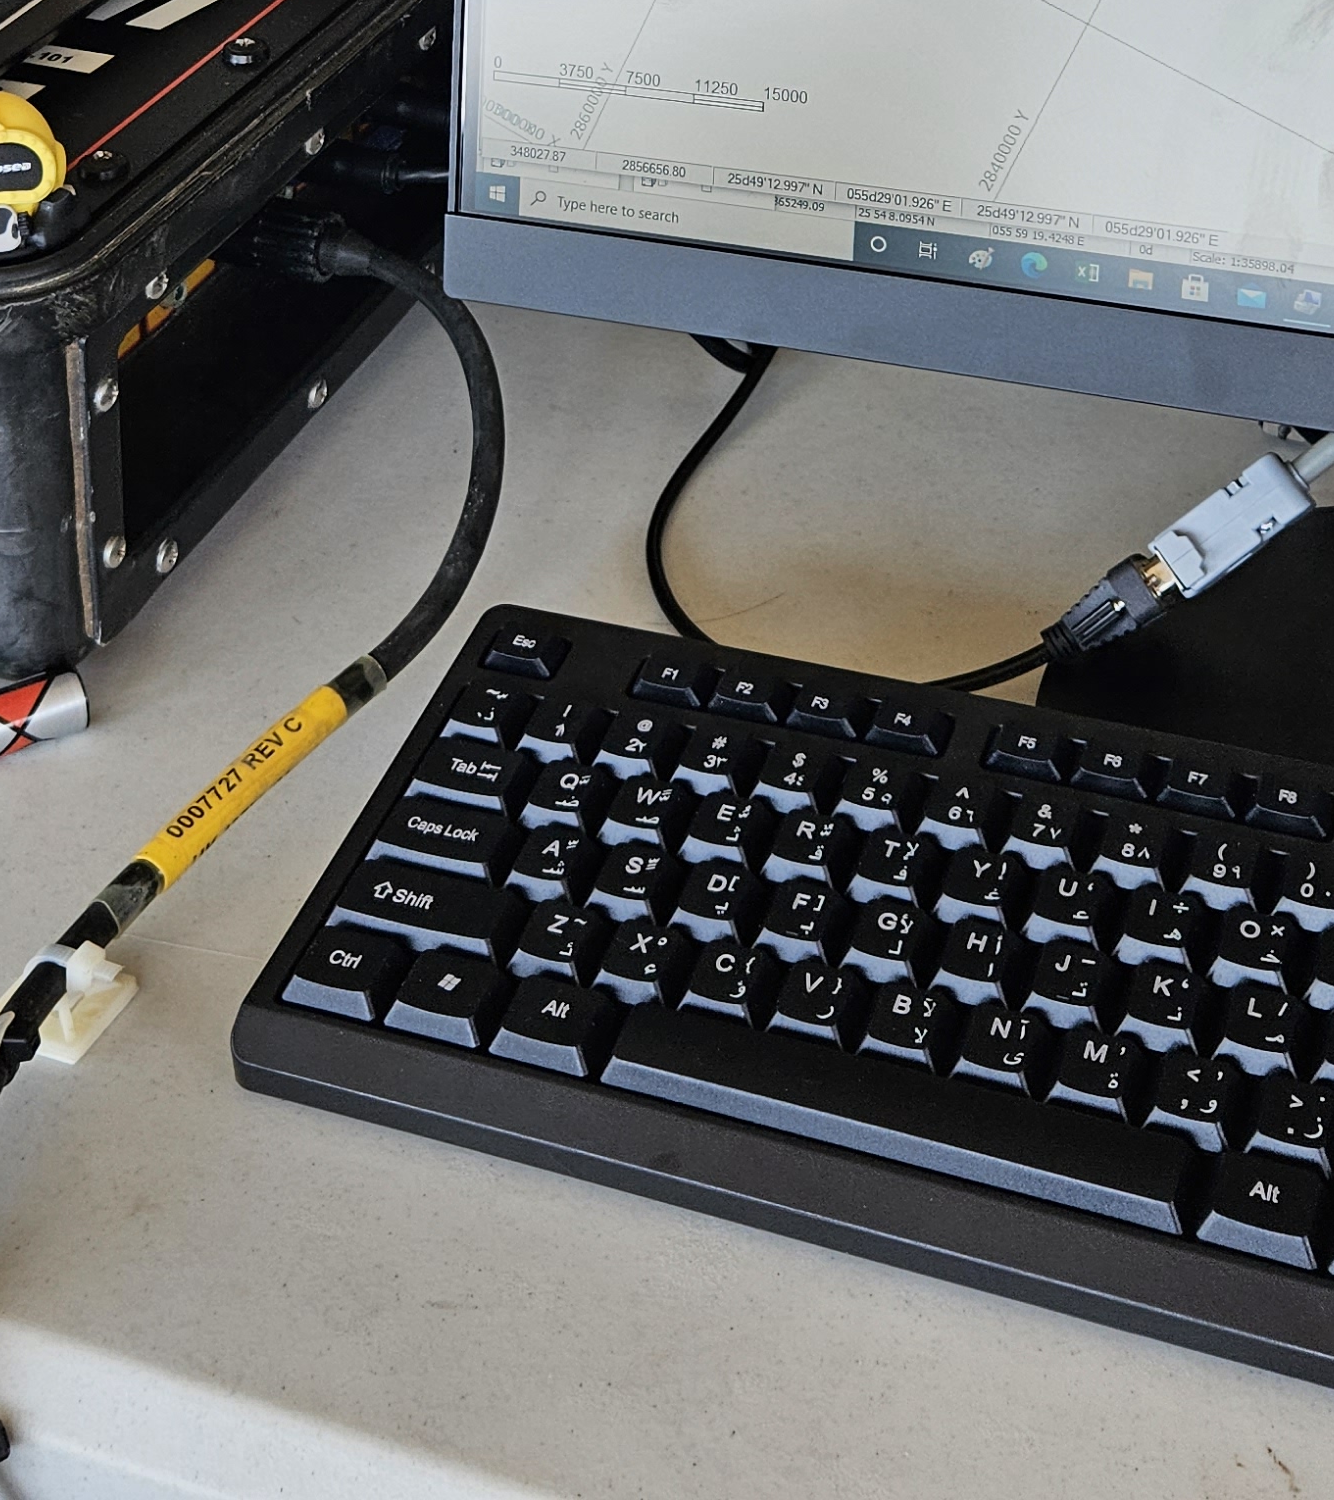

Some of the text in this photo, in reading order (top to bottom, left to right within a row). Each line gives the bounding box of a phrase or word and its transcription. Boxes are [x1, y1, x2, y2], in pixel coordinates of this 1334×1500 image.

[559, 63, 808, 104] 3750 7500 11250 15000
[978, 107, 1031, 194] 2840000 Y
[510, 145, 566, 163] 348027.87
[622, 159, 687, 178] 2856656.80
[812, 183, 823, 195] N
[942, 199, 952, 212] E
[1069, 216, 1080, 229] N
[1208, 234, 1219, 248] E
[557, 195, 680, 224] Type here to search
[1192, 250, 1226, 266] Scale:
[512, 635, 536, 649] Esc
[661, 667, 679, 680] F1
[893, 711, 912, 727] F4
[1018, 735, 1038, 750] F5
[450, 756, 477, 776] Tab
[166, 767, 244, 840] 0007727
[242, 731, 285, 770] REV
[283, 716, 303, 733] C
[1278, 788, 1298, 805] F8
[407, 815, 479, 842] Caps Lock
[392, 888, 435, 910] Shift
[328, 949, 363, 970] Ctrl
[541, 998, 569, 1019] Alt
